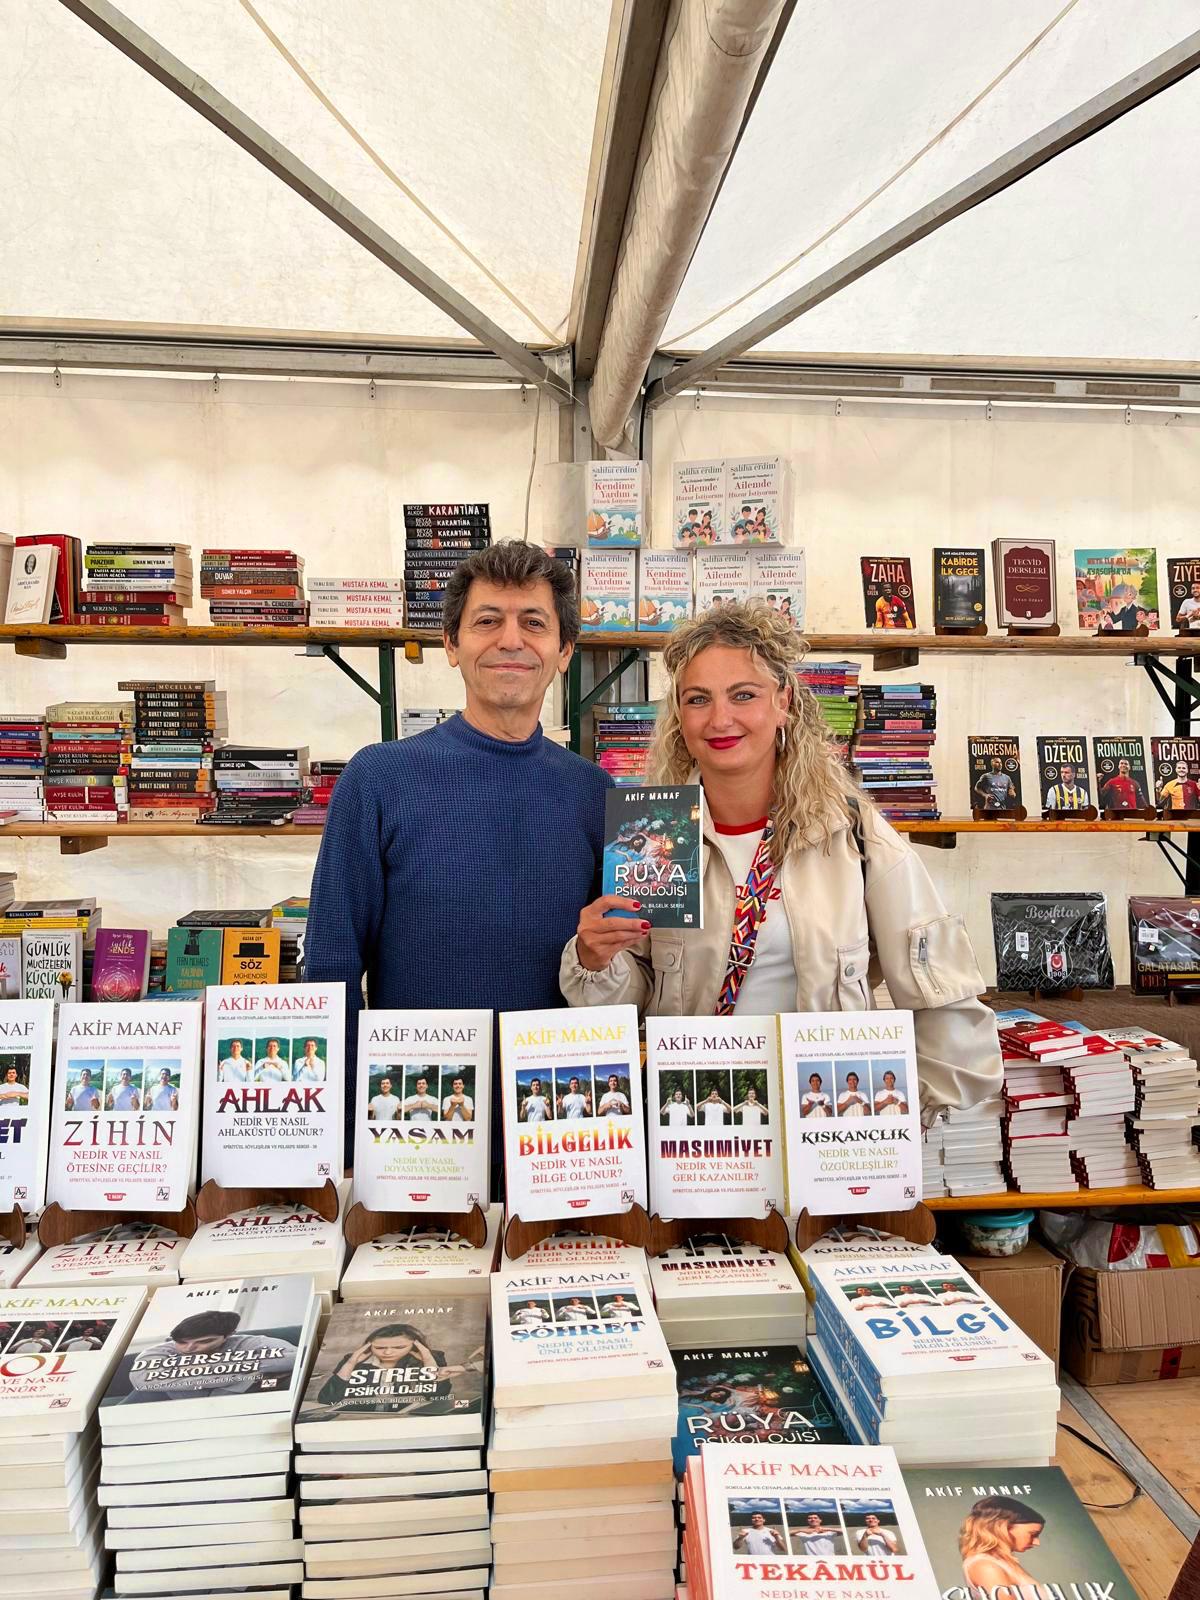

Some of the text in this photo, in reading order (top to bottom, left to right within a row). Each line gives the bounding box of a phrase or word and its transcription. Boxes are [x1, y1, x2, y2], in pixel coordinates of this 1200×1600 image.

[595, 482, 635, 490] Kendime
[735, 480, 771, 490] Ailemde
[600, 490, 631, 499] Yardım
[429, 504, 480, 516] KARANTİNA
[437, 518, 471, 527] KARANTİNA
[438, 529, 472, 537] KARANTİNA
[439, 540, 472, 548] KARANTİNA
[941, 557, 978, 566] KABİRDE
[1012, 558, 1042, 566] TECVİD
[870, 563, 906, 583] ZAHA
[941, 567, 979, 576] İLK GECE
[342, 580, 389, 589] MUSTAFA KEMAL
[346, 594, 392, 602] MUSTAFA KEMAL
[346, 606, 392, 614] MUSTAFA KEMAL
[345, 619, 390, 627] MUSTAFA KEMAL
[971, 743, 1018, 757] QUARESMA
[1097, 742, 1142, 757] RONALDO
[1158, 743, 1200, 761] ICARDI
[625, 791, 680, 802] AKİF MANAF
[615, 862, 687, 882] RÜYA
[615, 884, 687, 897] PSİKOLOJİSİ
[1025, 904, 1080, 920] Beşiktaş
[26, 940, 71, 957] GÜNLÜK
[27, 958, 72, 970] MUCİZELERİN
[240, 958, 263, 970] SÖZ
[26, 969, 62, 987] KÜÇÜK
[25, 988, 55, 1000] KURSU
[217, 995, 328, 1011] AKİF MANAF
[69, 1019, 183, 1036] AKİF MANAF
[369, 1025, 477, 1042] AKİF MANAF
[794, 1025, 903, 1042] AKİF MANAF
[514, 1025, 626, 1047] AKİF MANAF
[656, 1034, 766, 1051] AKİF MANAF
[216, 1088, 326, 1113] AHLAK
[233, 1117, 309, 1127] NEDİR VE NASIL
[63, 1114, 176, 1146] ZİHİN
[217, 1127, 324, 1137] AHLAKÜSTÜ OLUNUR?
[368, 1127, 476, 1150] YAŞAM
[519, 1121, 634, 1157] BİLGELİK
[801, 1128, 912, 1147] KISKANÇLIK
[660, 1136, 773, 1158] MASUMİYET
[818, 1147, 898, 1159] NEDİR VE NASIL
[73, 1149, 163, 1160] NEDİR VE NASIL
[66, 1162, 168, 1175] ÖTESİNE GEÇİLİR?
[531, 1157, 622, 1171] NEDİR VE NASIL
[676, 1160, 755, 1170] NEDİR VE NASIL
[820, 1159, 899, 1173] ÖZGÜRLEŞİLİR?
[532, 1168, 623, 1184] BİLGE OLUNUR?
[672, 1172, 759, 1182] GERİ KAZANILIR?
[211, 1214, 326, 1229] AHLAK
[54, 1240, 181, 1259] ZİHİN
[813, 1245, 924, 1255] KISKANÇLIK
[661, 1258, 777, 1272] MASUMİYET
[833, 1262, 952, 1276] AKİF MANAF
[506, 1276, 552, 1288] AKİF
[558, 1272, 630, 1285] MANAF
[186, 1285, 279, 1298] AKİF MANAF
[364, 1307, 454, 1317] AKİF MANAF
[865, 1306, 1010, 1340] BİLGİ
[510, 1321, 647, 1343] ŞÖHRET
[130, 1346, 287, 1372] DEĞERSİZLİK
[683, 1351, 769, 1361] AKİF MANAF
[146, 1360, 261, 1381] PSİKOLOJİSİ
[348, 1366, 439, 1386] STRES
[344, 1381, 438, 1398] PSİKOLOJİSİ
[686, 1411, 816, 1434] RÜYA
[723, 1461, 883, 1478] AKİF MANAF
[925, 1484, 1033, 1497] AKİF MANAF
[736, 1560, 915, 1582] TEKÂMÜL
[761, 1590, 890, 1600] NEDİR VE NASIL
